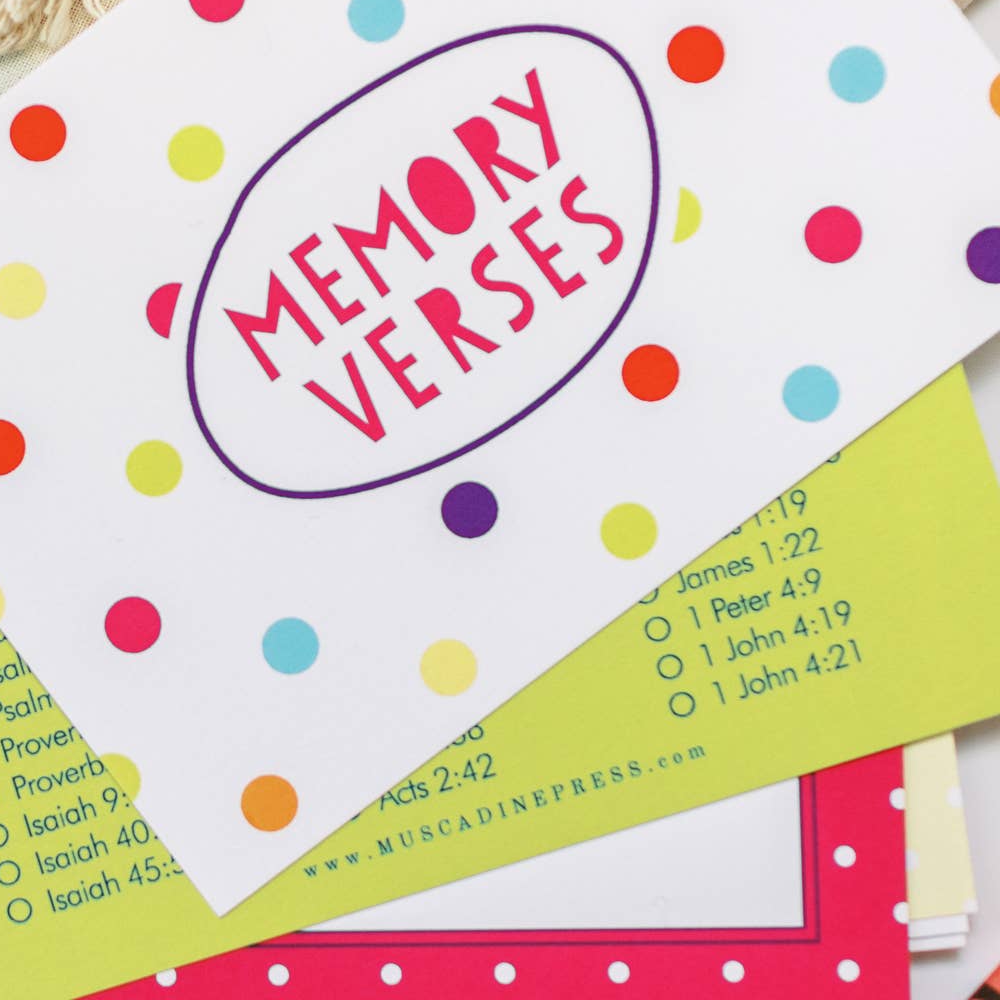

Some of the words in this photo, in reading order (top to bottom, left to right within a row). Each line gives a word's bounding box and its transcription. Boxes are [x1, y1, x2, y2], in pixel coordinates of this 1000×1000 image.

[223, 67, 560, 382] MEMORY
[303, 175, 624, 442] VERSES
[676, 556, 754, 594] James
[760, 527, 823, 565] 1:22
[688, 605, 701, 630] 1
[710, 590, 773, 623] Peter
[781, 568, 822, 600] 4:9
[700, 643, 713, 667] 1
[727, 627, 786, 662] John
[793, 600, 851, 637] 4:19
[712, 681, 726, 705] 1
[738, 665, 798, 699] John
[805, 639, 862, 675] 4:21
[0, 725, 84, 763] Prover
[11, 752, 105, 800] Proverb
[377, 779, 430, 811] Acts
[433, 752, 497, 793] 2:42
[23, 796, 97, 838] Isaiah
[102, 786, 130, 813] 9:
[303, 743, 707, 878] www.MUSCADINEPRESS.com
[35, 832, 110, 875] Isaiah
[47, 870, 122, 913] Isaiah
